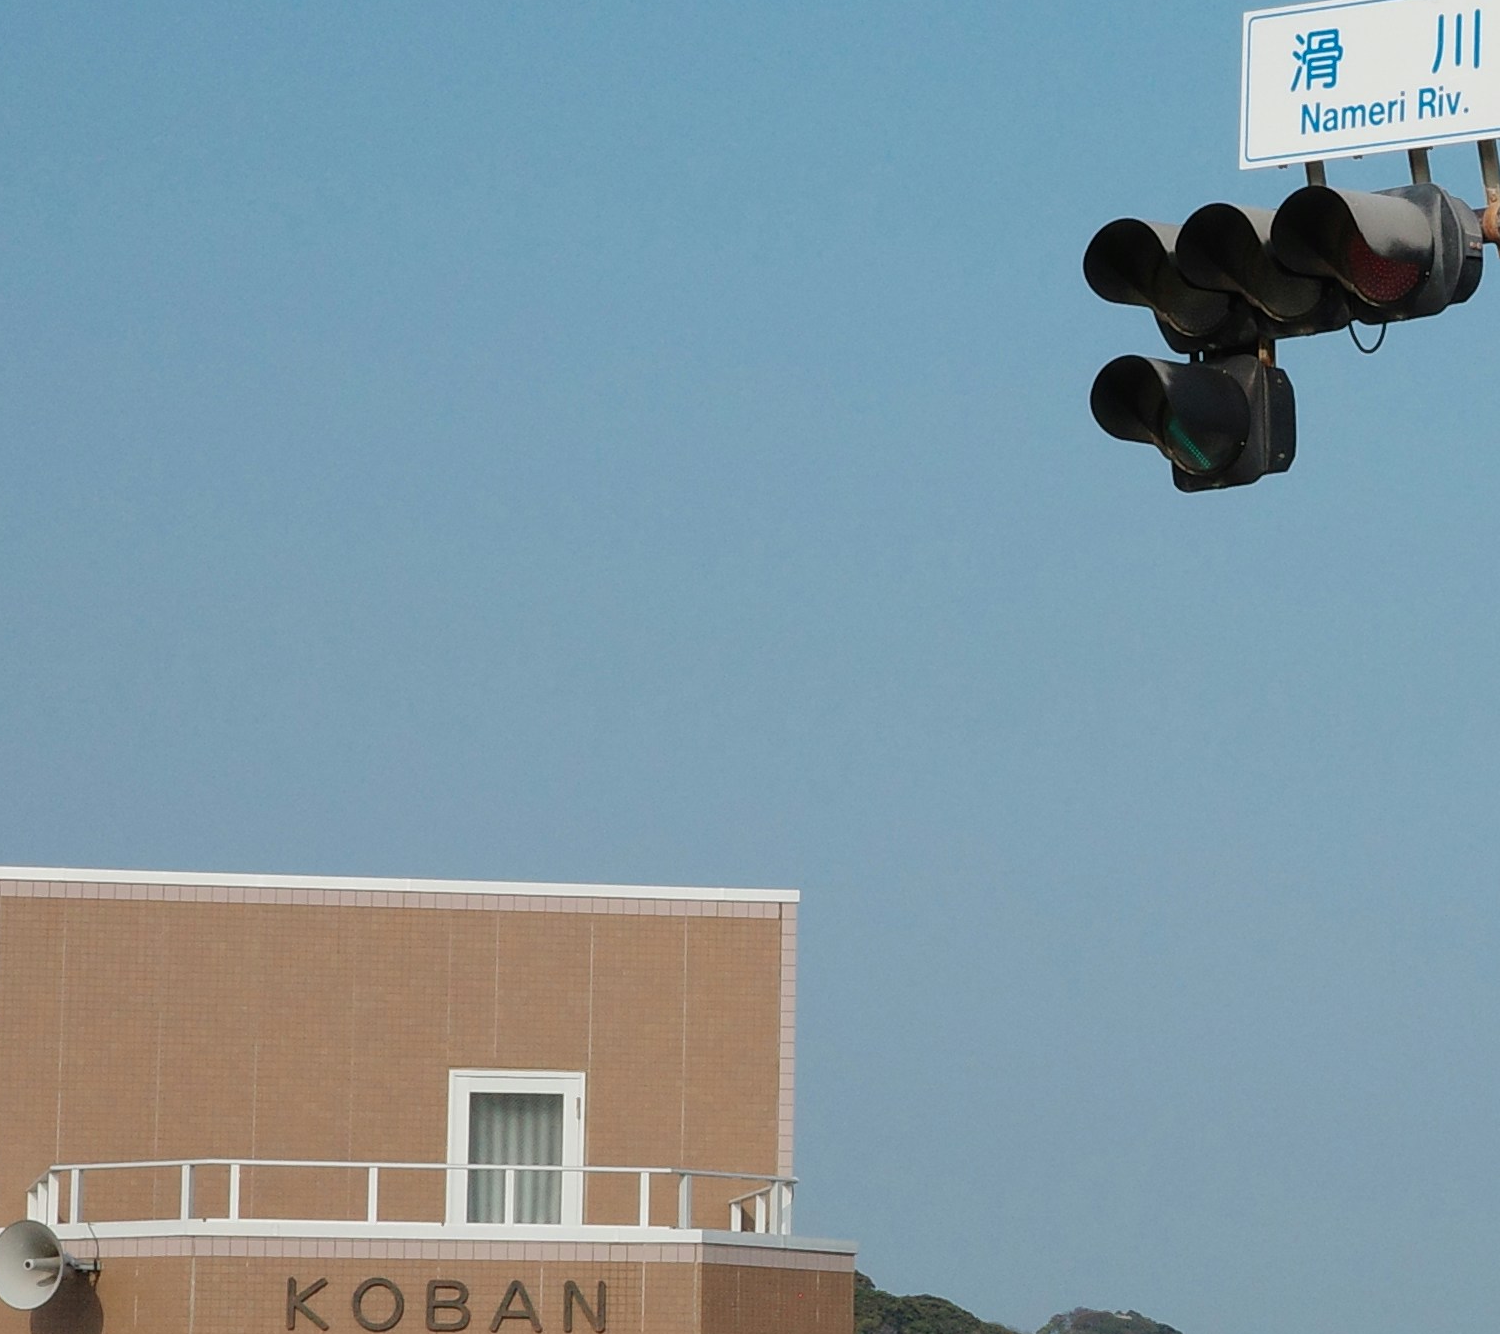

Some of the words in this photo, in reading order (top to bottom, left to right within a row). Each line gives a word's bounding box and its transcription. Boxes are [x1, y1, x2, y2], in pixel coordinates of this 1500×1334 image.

[1289, 7, 1481, 93] 滑川
[1300, 89, 1406, 136] Nameri
[1418, 85, 1470, 120] Riv.
[286, 1276, 607, 1334] KOBAN
